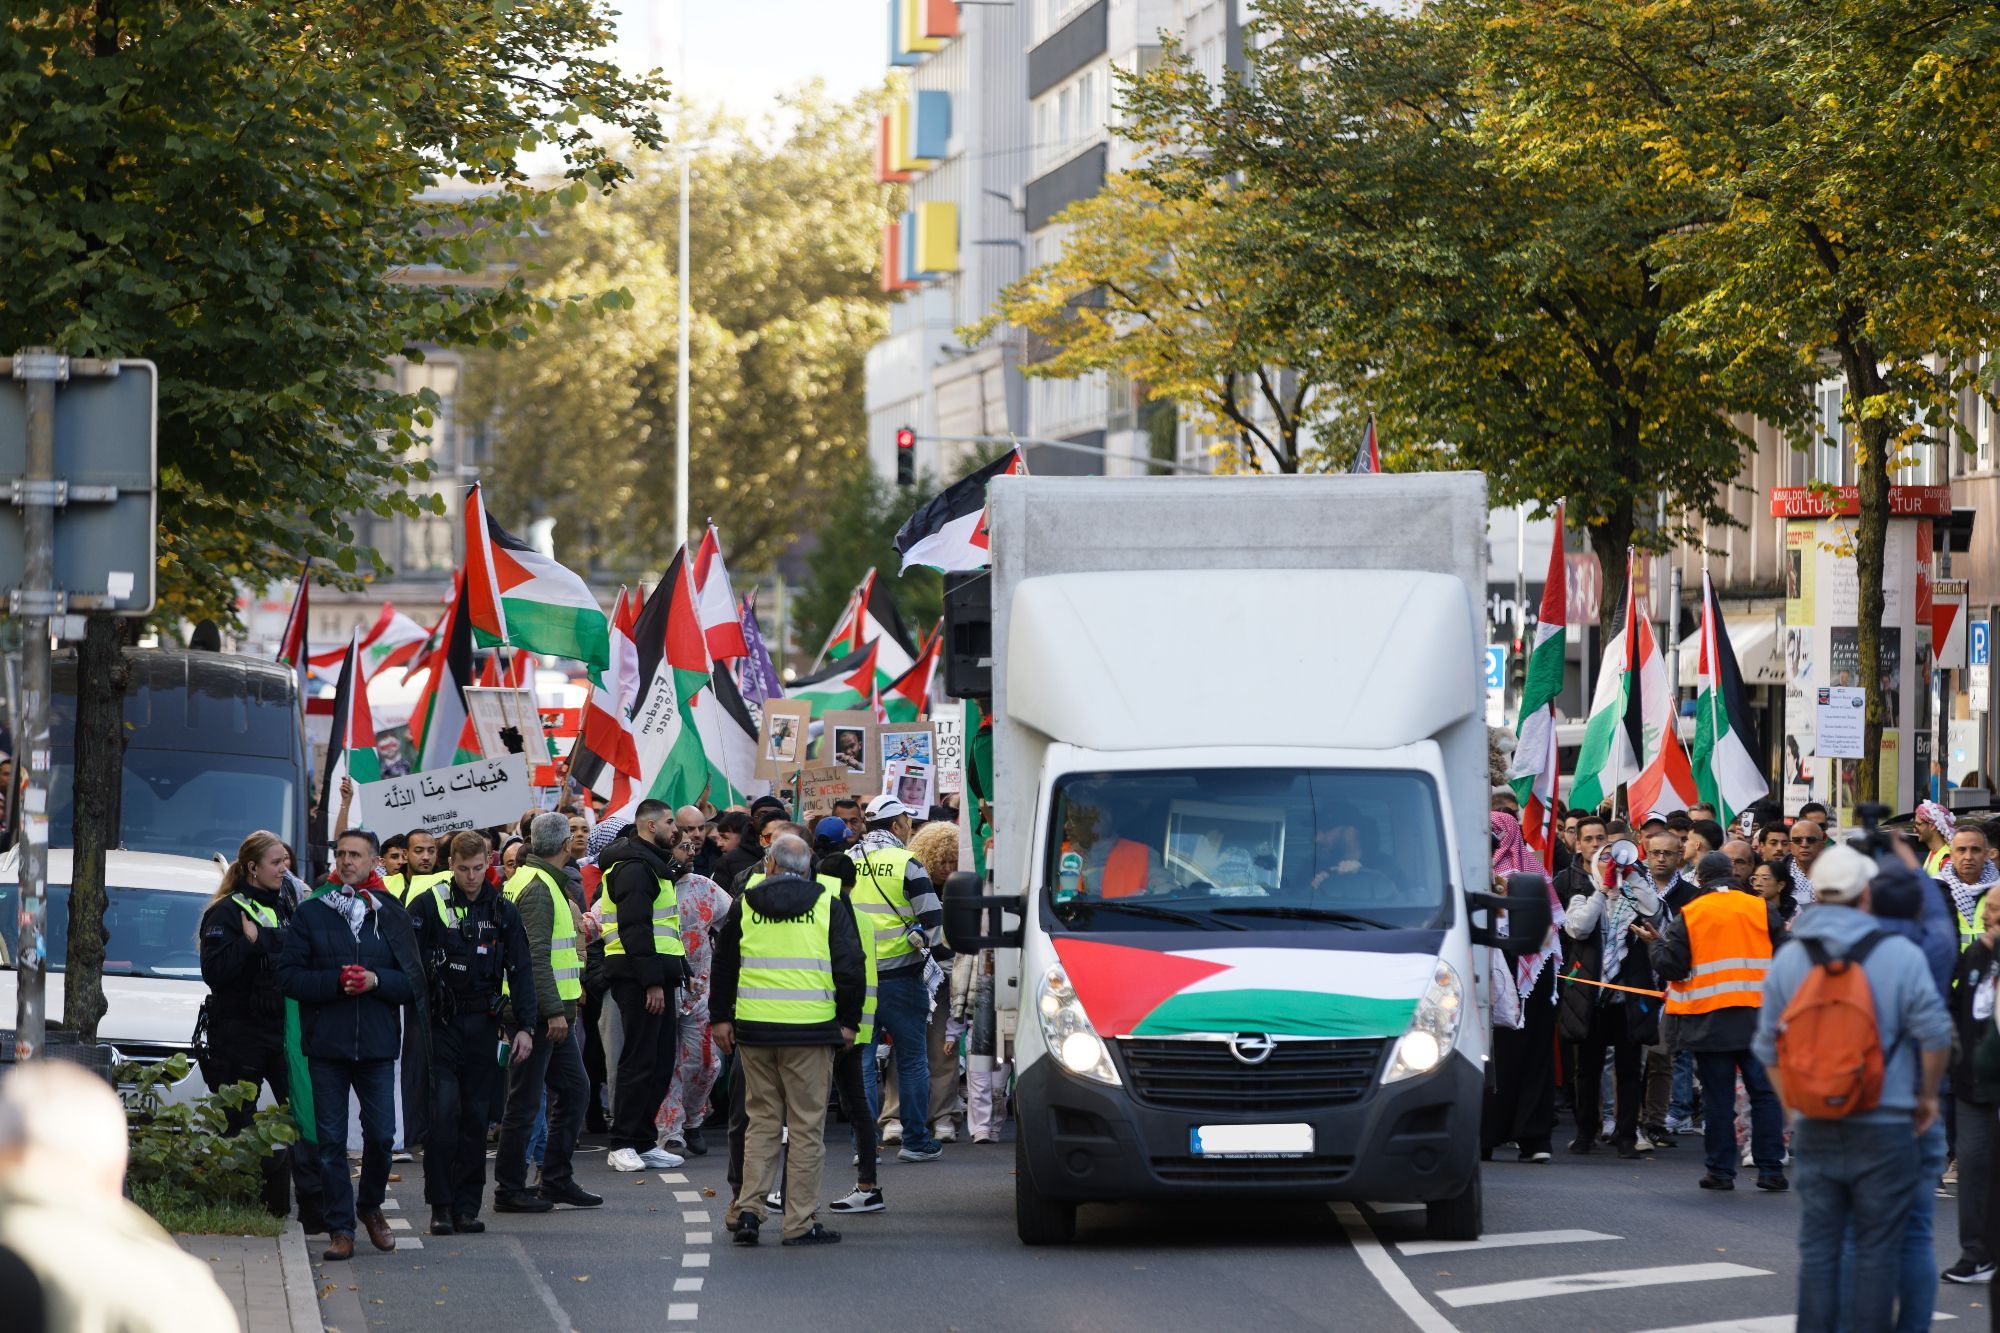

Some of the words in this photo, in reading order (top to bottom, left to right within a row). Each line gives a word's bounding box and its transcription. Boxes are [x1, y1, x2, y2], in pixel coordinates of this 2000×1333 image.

[819, 783, 848, 796] NEVER
[422, 810, 458, 825] Niemals
[427, 820, 473, 834] rdrückung
[856, 863, 893, 877] RDNER
[449, 962, 467, 972] POLIZEI
